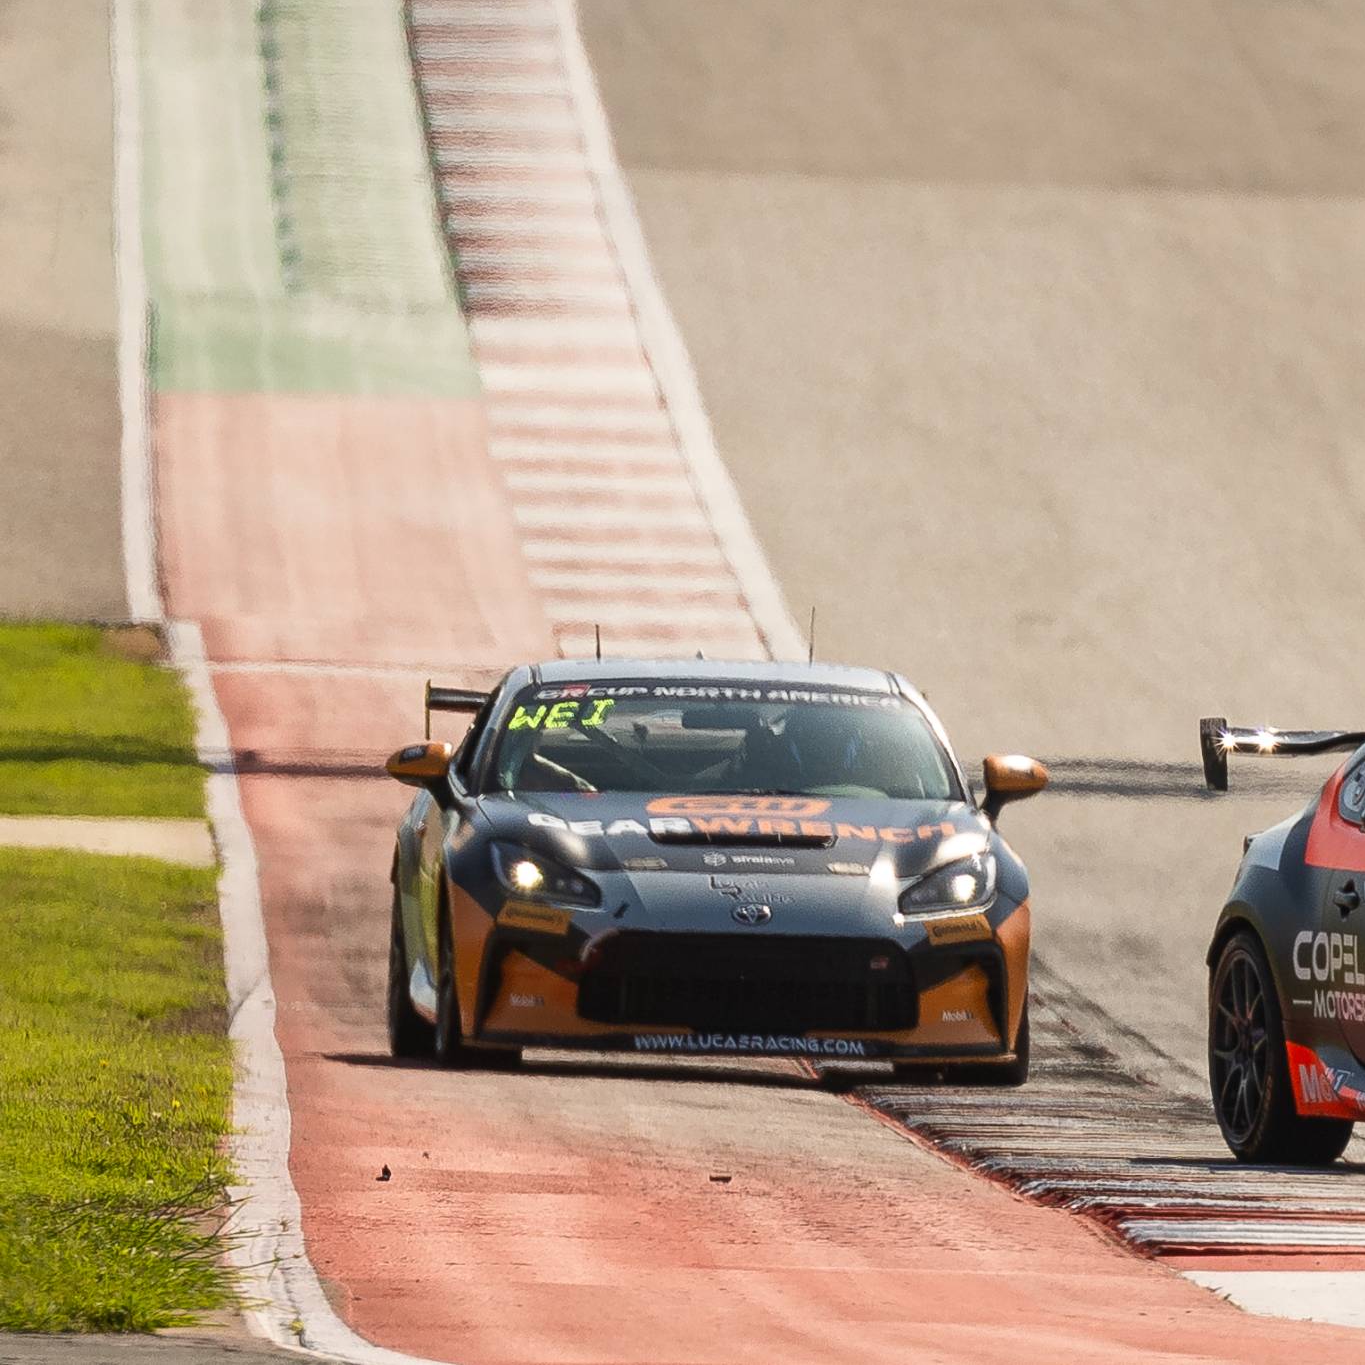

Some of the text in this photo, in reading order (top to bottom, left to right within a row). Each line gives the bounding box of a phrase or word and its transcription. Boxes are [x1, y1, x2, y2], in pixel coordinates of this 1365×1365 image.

[652, 686, 762, 701] NORTH
[767, 690, 903, 709] AMERICA
[508, 698, 616, 731] WEI
[527, 812, 957, 845] GEARWRENCH
[634, 1034, 866, 1056] WWW.LUCASRACING.COM
